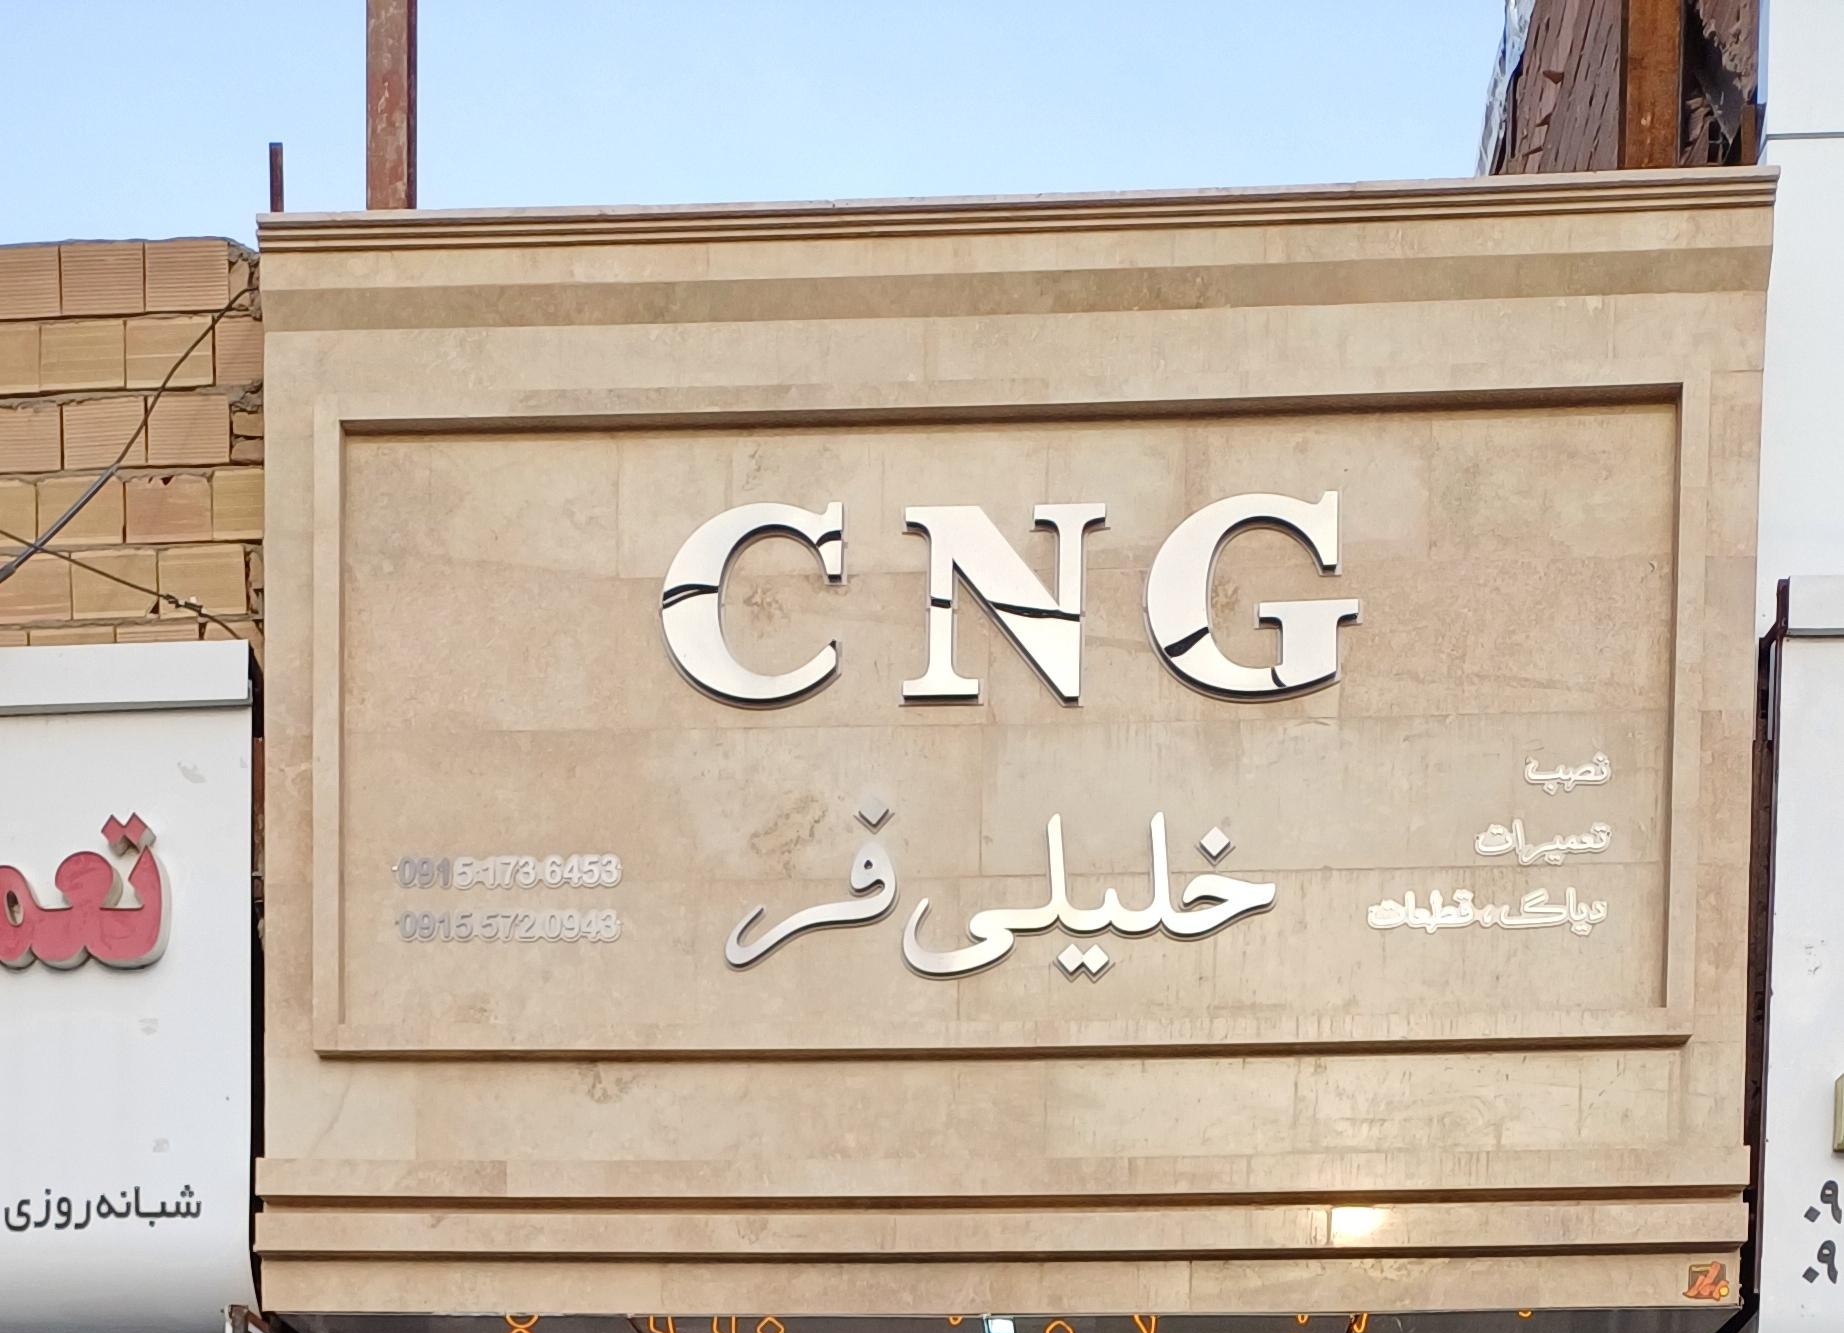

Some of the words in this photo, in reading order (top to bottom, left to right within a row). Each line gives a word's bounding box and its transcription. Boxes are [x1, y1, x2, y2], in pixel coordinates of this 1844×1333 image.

[659, 489, 1362, 710] CNG
[1475, 818, 1612, 866] تعمیرات
[1524, 752, 1611, 795] نصب
[724, 803, 897, 971] فر
[902, 811, 1278, 982] خلیلی
